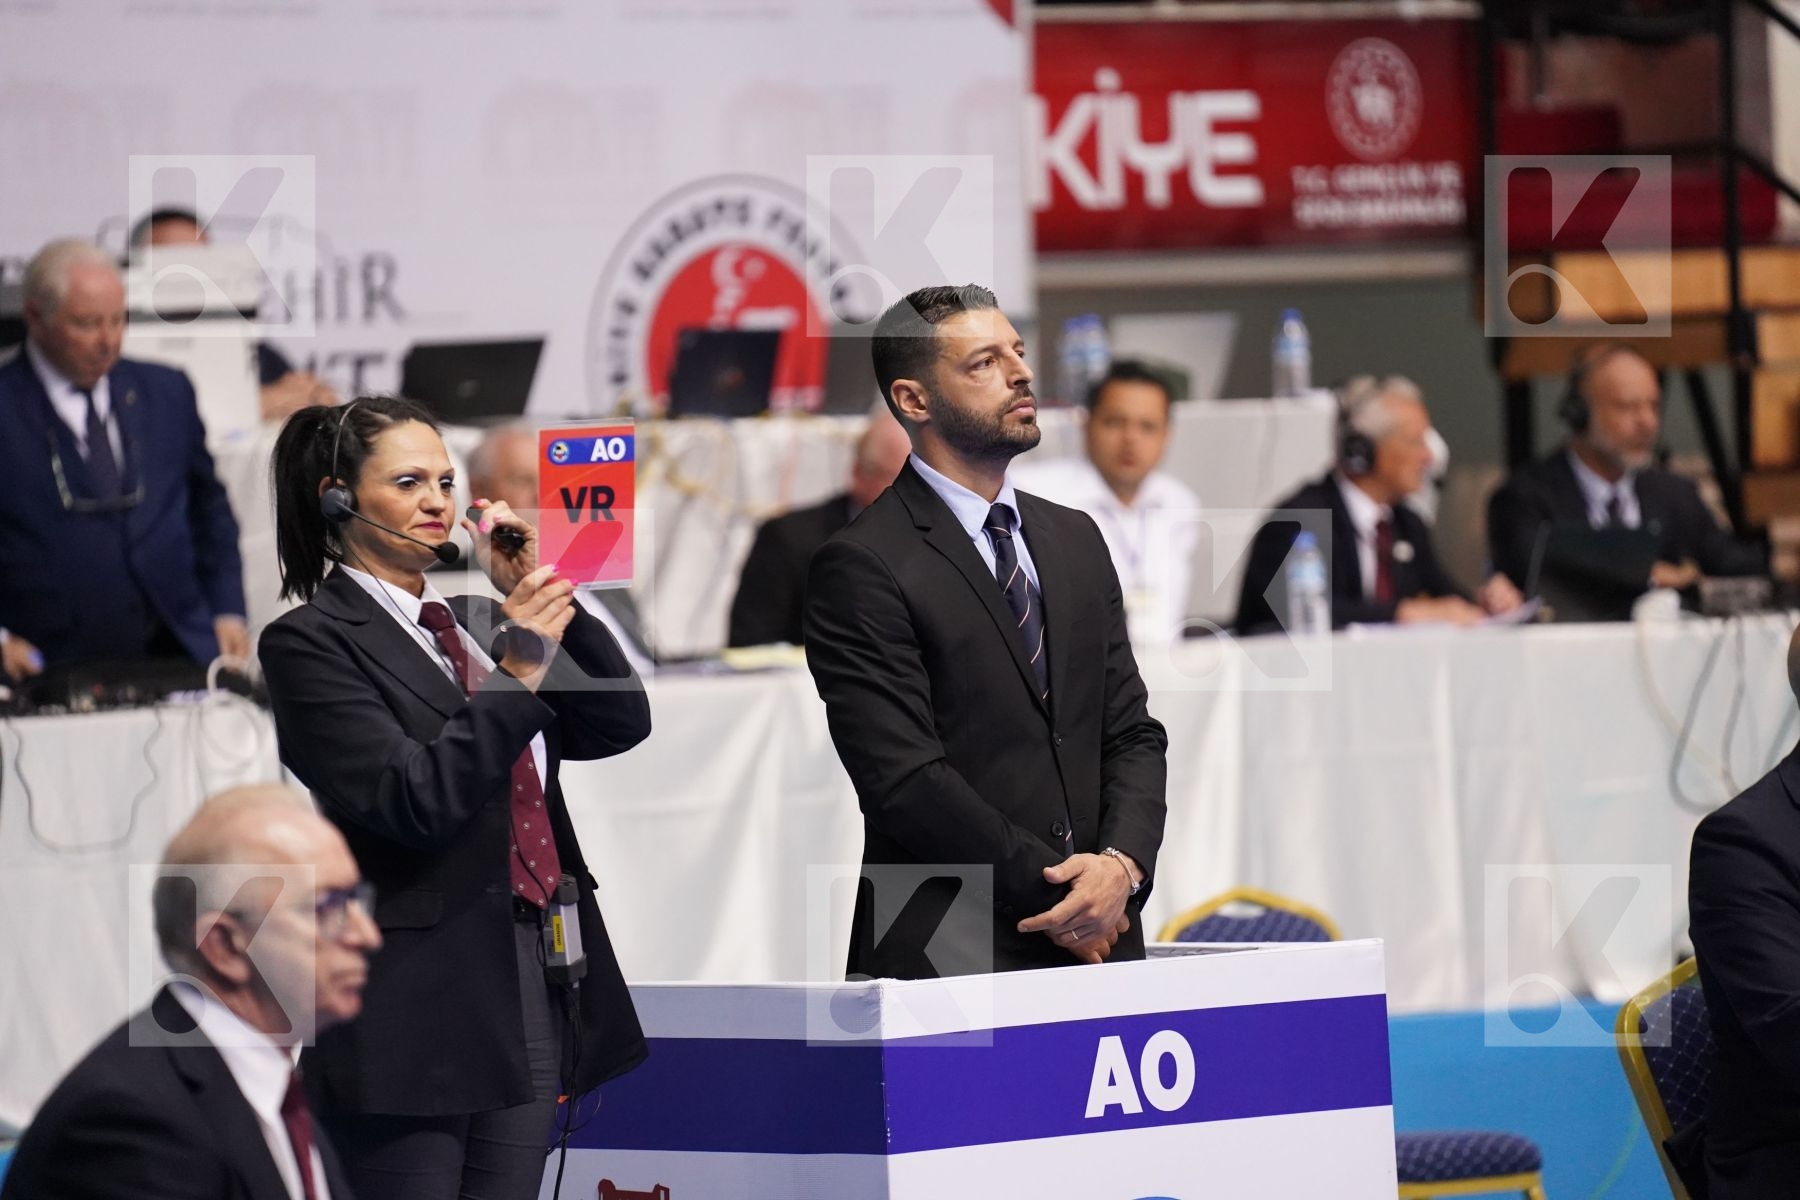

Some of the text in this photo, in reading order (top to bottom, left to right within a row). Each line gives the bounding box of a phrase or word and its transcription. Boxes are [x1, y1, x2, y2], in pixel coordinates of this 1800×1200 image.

[590, 436, 627, 463] AO
[559, 485, 616, 524] VR
[1084, 1029, 1196, 1119] AO
